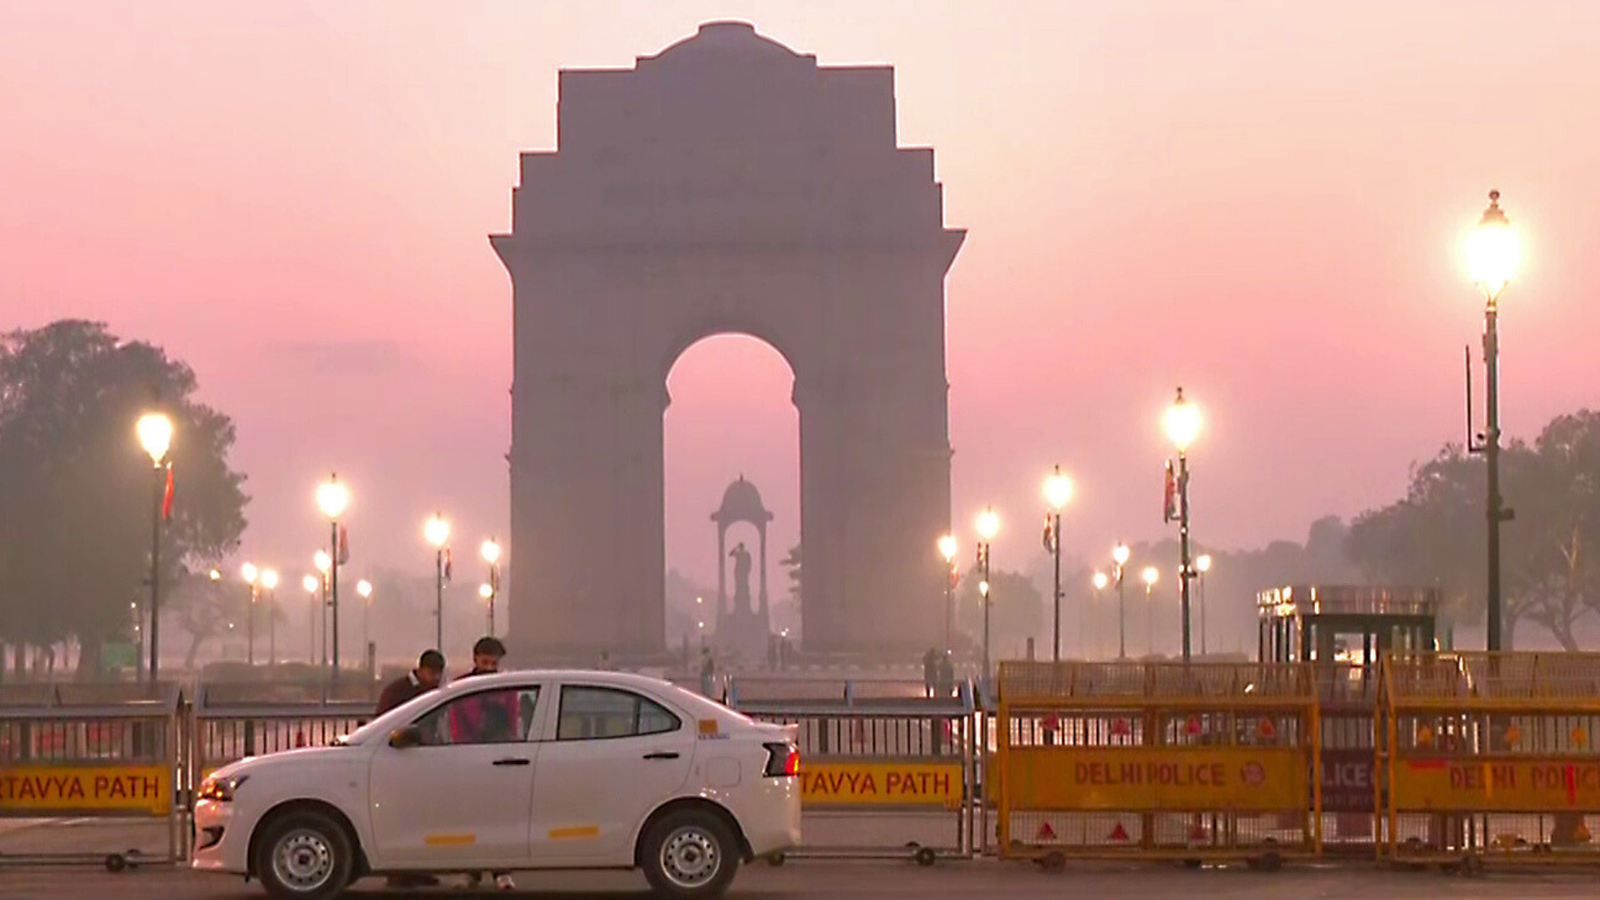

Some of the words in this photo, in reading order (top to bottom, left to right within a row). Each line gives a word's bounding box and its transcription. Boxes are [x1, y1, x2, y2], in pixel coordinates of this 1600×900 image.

[800, 771, 876, 794] TAVYA
[886, 771, 950, 795] PATH
[1075, 762, 1141, 785] DELHI
[1147, 762, 1226, 786] POLICE
[1531, 765, 1600, 790] POLIC
[0, 775, 84, 799] TAVYA
[95, 775, 158, 799] PATH
